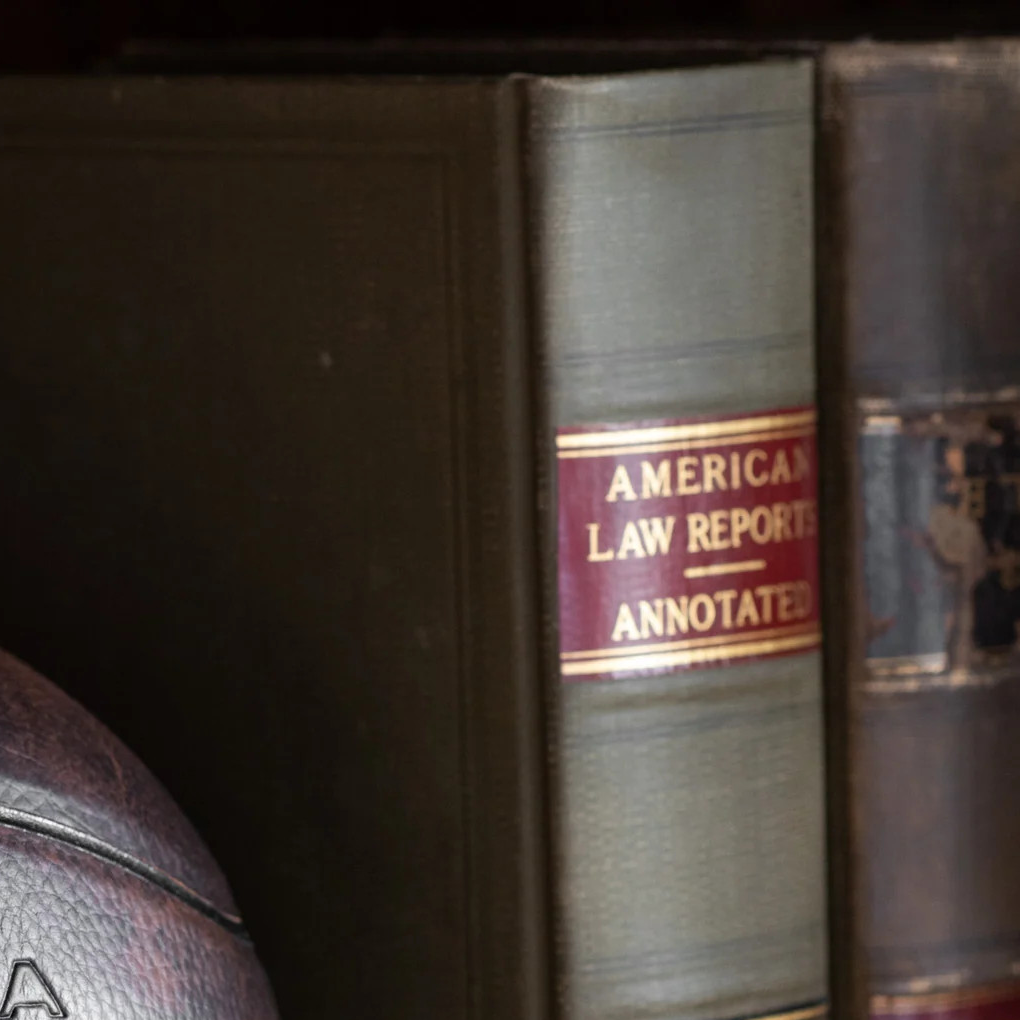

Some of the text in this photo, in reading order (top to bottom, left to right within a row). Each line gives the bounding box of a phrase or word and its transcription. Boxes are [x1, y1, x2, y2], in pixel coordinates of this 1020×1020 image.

[605, 444, 810, 502] AMERICAN
[586, 515, 676, 562] LAW
[611, 580, 813, 641] ANNOTATED
